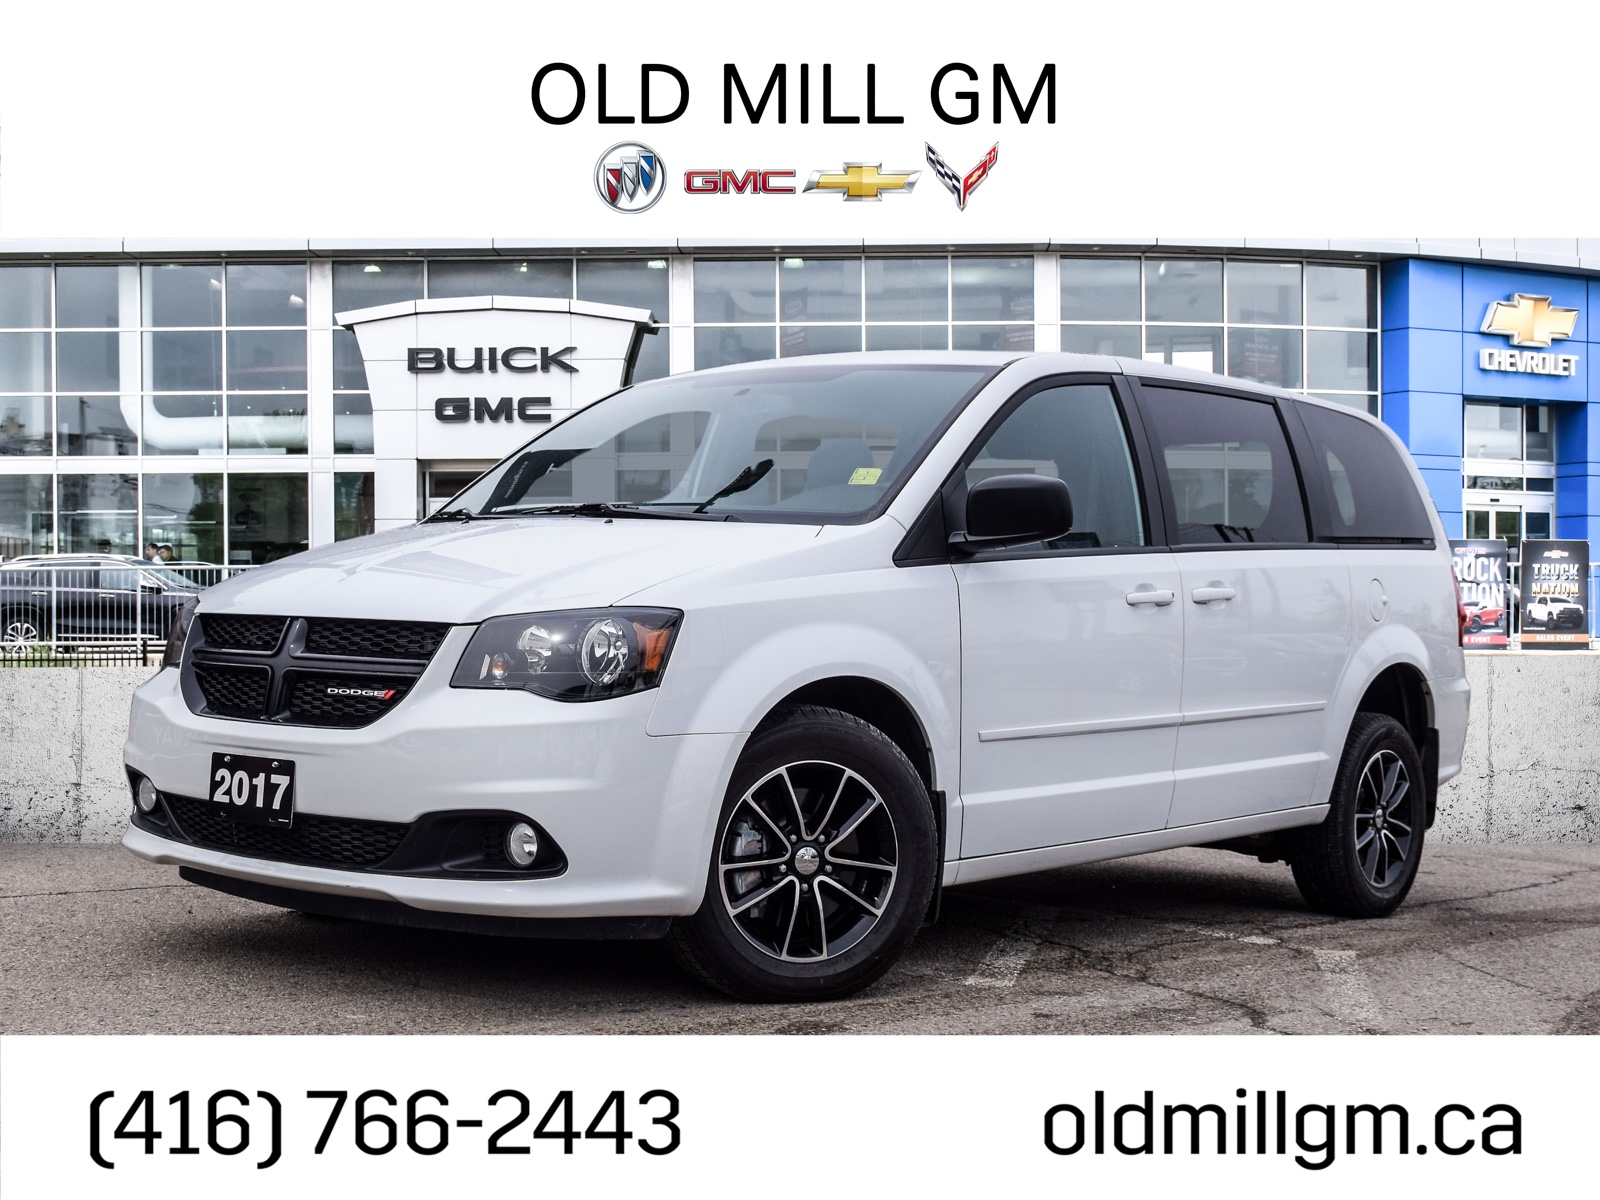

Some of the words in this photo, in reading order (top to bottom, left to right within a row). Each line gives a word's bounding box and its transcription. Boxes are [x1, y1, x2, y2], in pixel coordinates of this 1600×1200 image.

[407, 346, 579, 375] BUICK
[1479, 348, 1579, 377] CHEVROLET
[435, 396, 552, 424] GMC
[1453, 557, 1503, 582] RUCK
[1532, 563, 1580, 580] TRUCK
[1458, 583, 1504, 609] TION
[1531, 582, 1580, 598] NATION
[327, 687, 386, 697] DODGE
[213, 768, 291, 810] 2017
